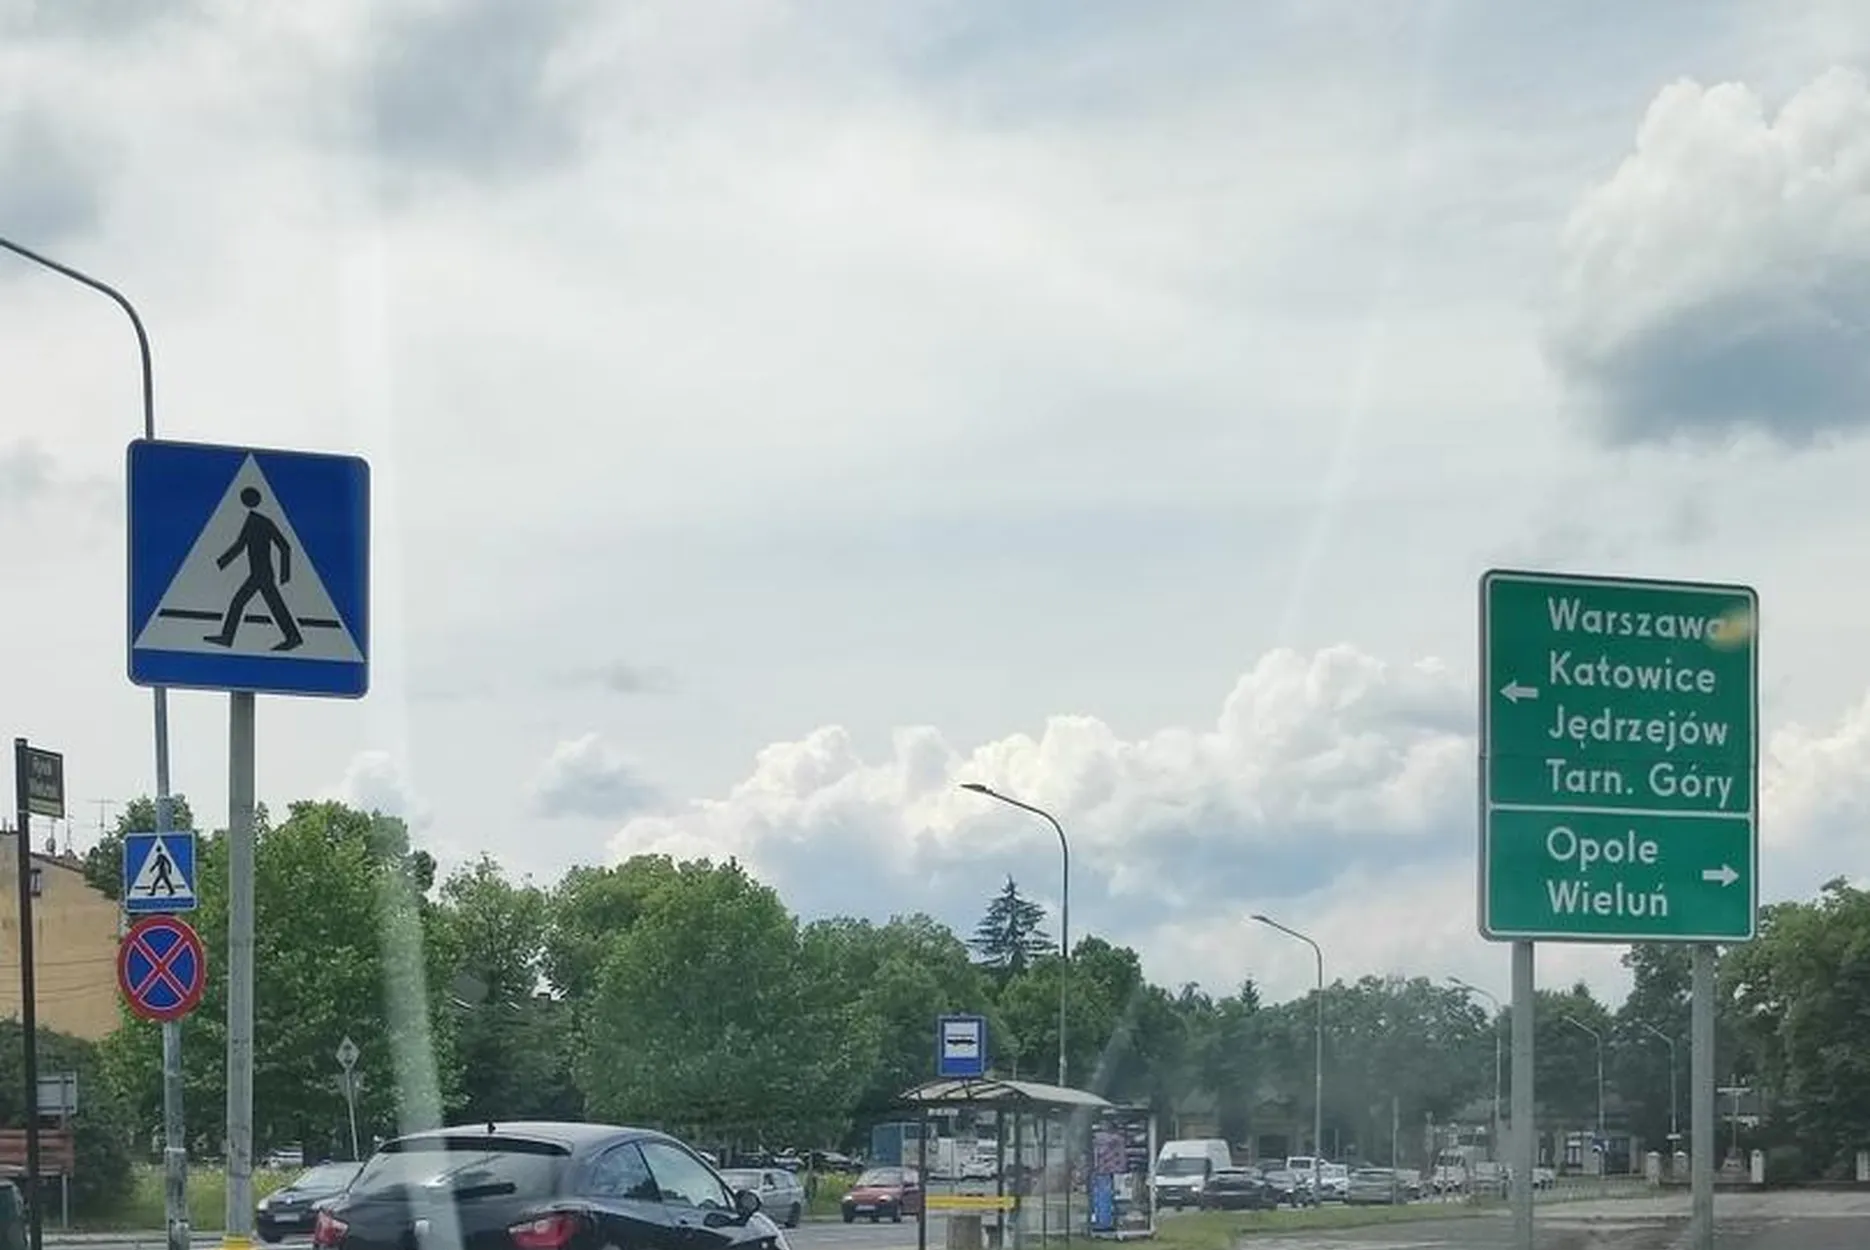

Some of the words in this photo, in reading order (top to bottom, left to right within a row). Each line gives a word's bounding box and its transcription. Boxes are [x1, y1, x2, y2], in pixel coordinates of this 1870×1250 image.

[1549, 650, 1716, 693] Katowice
[1547, 704, 1728, 752] Jędrzejów
[1546, 758, 1634, 796] Tarn.
[1648, 762, 1733, 808] Góry
[1546, 827, 1660, 872] Opole
[1547, 879, 1669, 917] Wieluń
